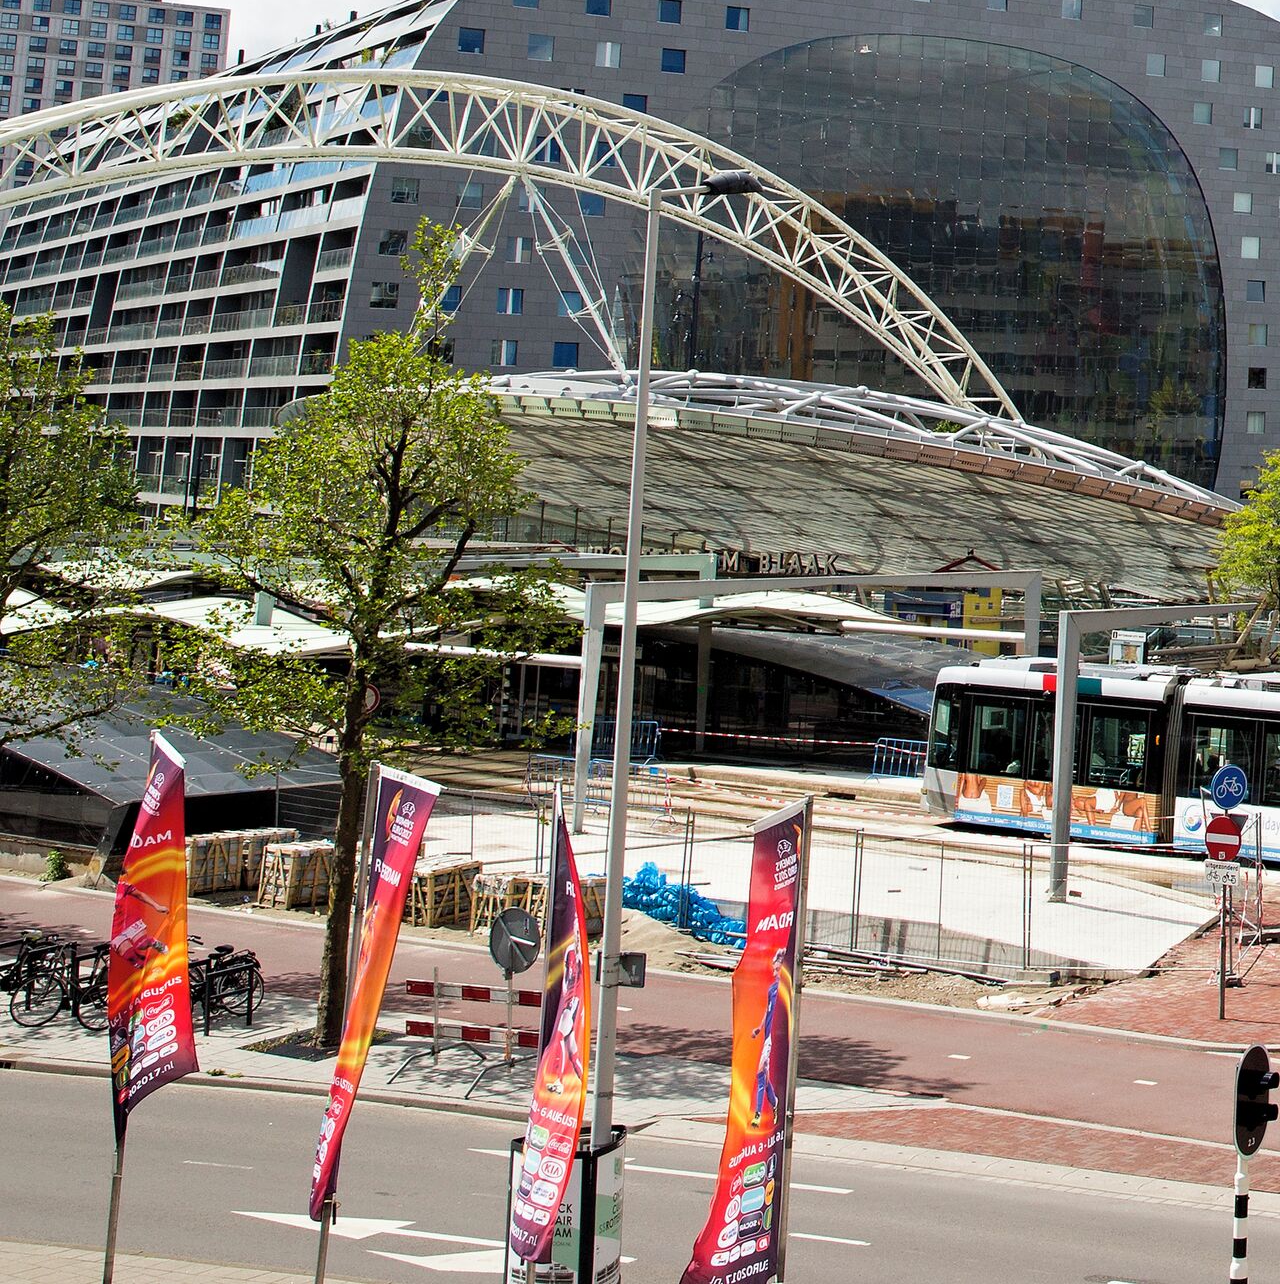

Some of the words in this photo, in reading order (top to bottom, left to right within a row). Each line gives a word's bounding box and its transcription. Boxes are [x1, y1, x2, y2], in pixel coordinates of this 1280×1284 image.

[759, 551, 840, 575] BLAAK
[540, 1107, 547, 1117] 6
[544, 1162, 561, 1177] KIA
